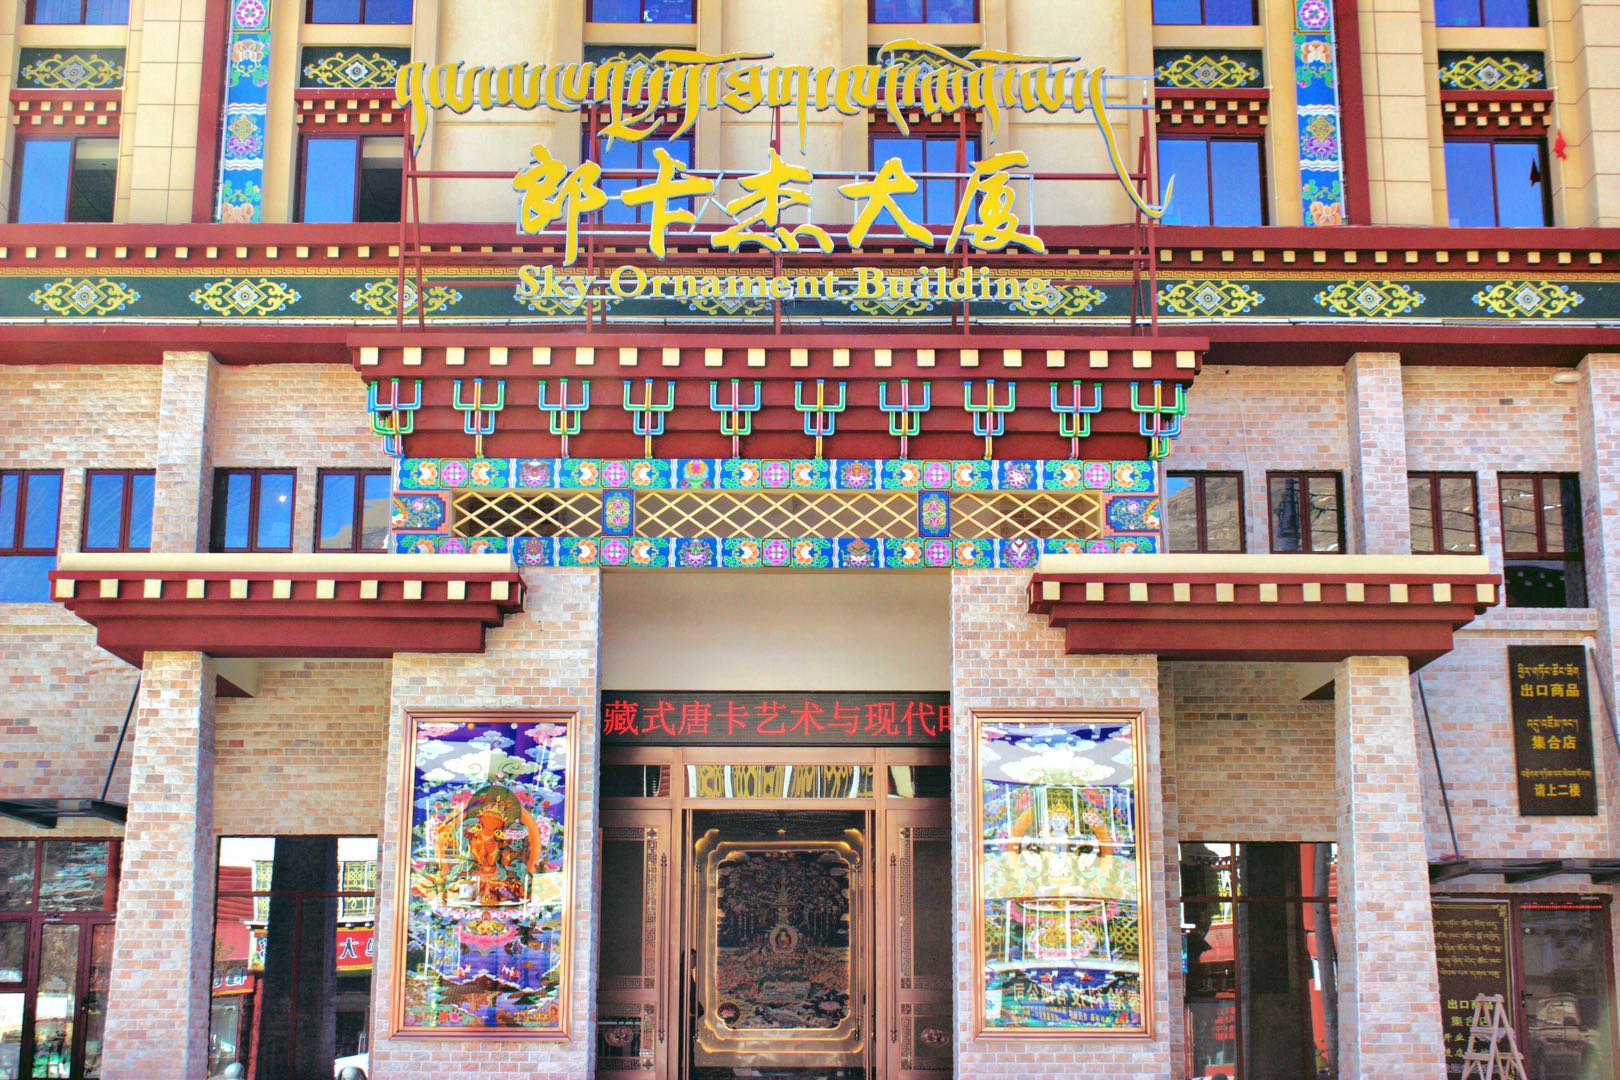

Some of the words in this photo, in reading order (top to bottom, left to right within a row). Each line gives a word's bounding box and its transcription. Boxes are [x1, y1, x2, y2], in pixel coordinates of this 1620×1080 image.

[512, 144, 1047, 266] 郎卡杰大厦
[516, 265, 595, 301] Sky
[609, 264, 840, 300] Ornament
[853, 266, 1050, 309] Building
[1520, 683, 1580, 698] 出口商品
[1531, 735, 1577, 750] 集合店
[1534, 783, 1581, 798] 请上二楼
